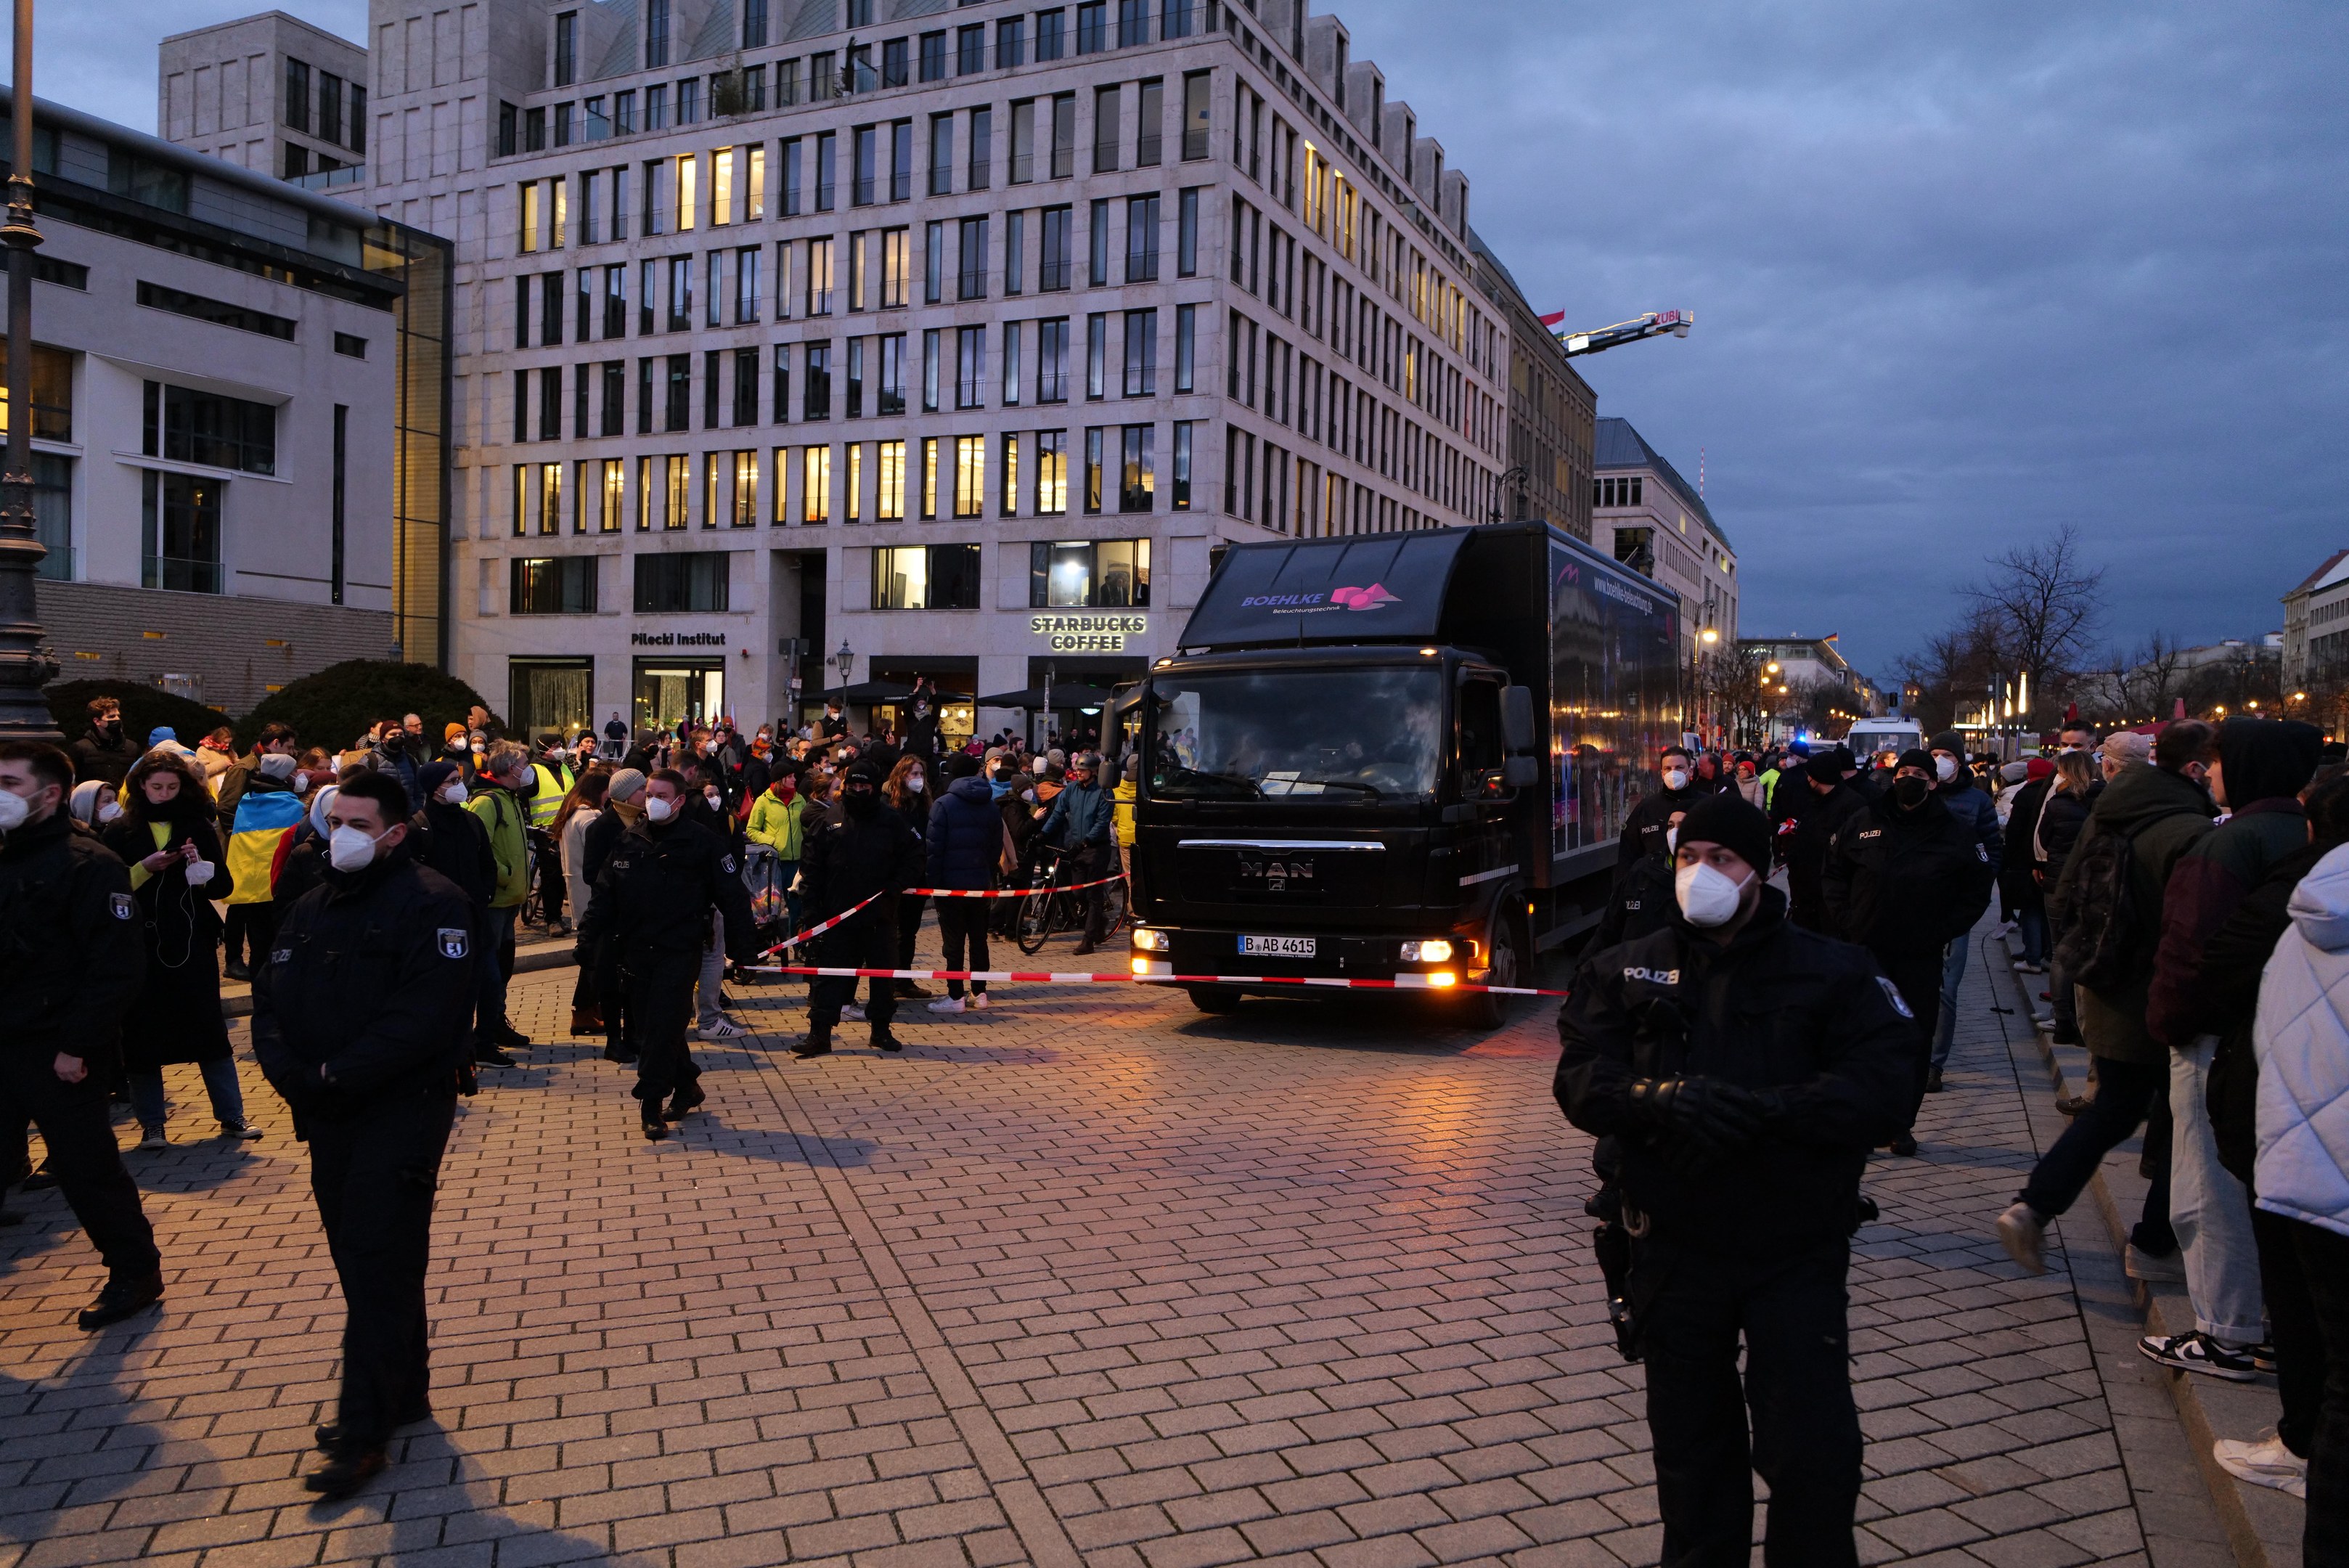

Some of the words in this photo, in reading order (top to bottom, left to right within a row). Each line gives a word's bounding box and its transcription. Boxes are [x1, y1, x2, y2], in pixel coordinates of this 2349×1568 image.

[1241, 593, 1325, 607] BOEHLKE
[1593, 576, 1653, 616] www.boehlke-beleuchtung.de
[1272, 605, 1341, 614] Beleuchtungstechnik
[1031, 617, 1145, 632] STARBUCKS
[632, 633, 674, 645] Pilecki
[677, 633, 726, 645] Institut
[1051, 635, 1122, 650] COFFEE
[1859, 829, 1882, 840] POLIZEI
[1241, 862, 1312, 878] MAN
[1246, 937, 1254, 951] B
[1262, 938, 1279, 952] AB
[1282, 939, 1315, 953] 4615
[1623, 967, 1680, 984] POLIZEI
